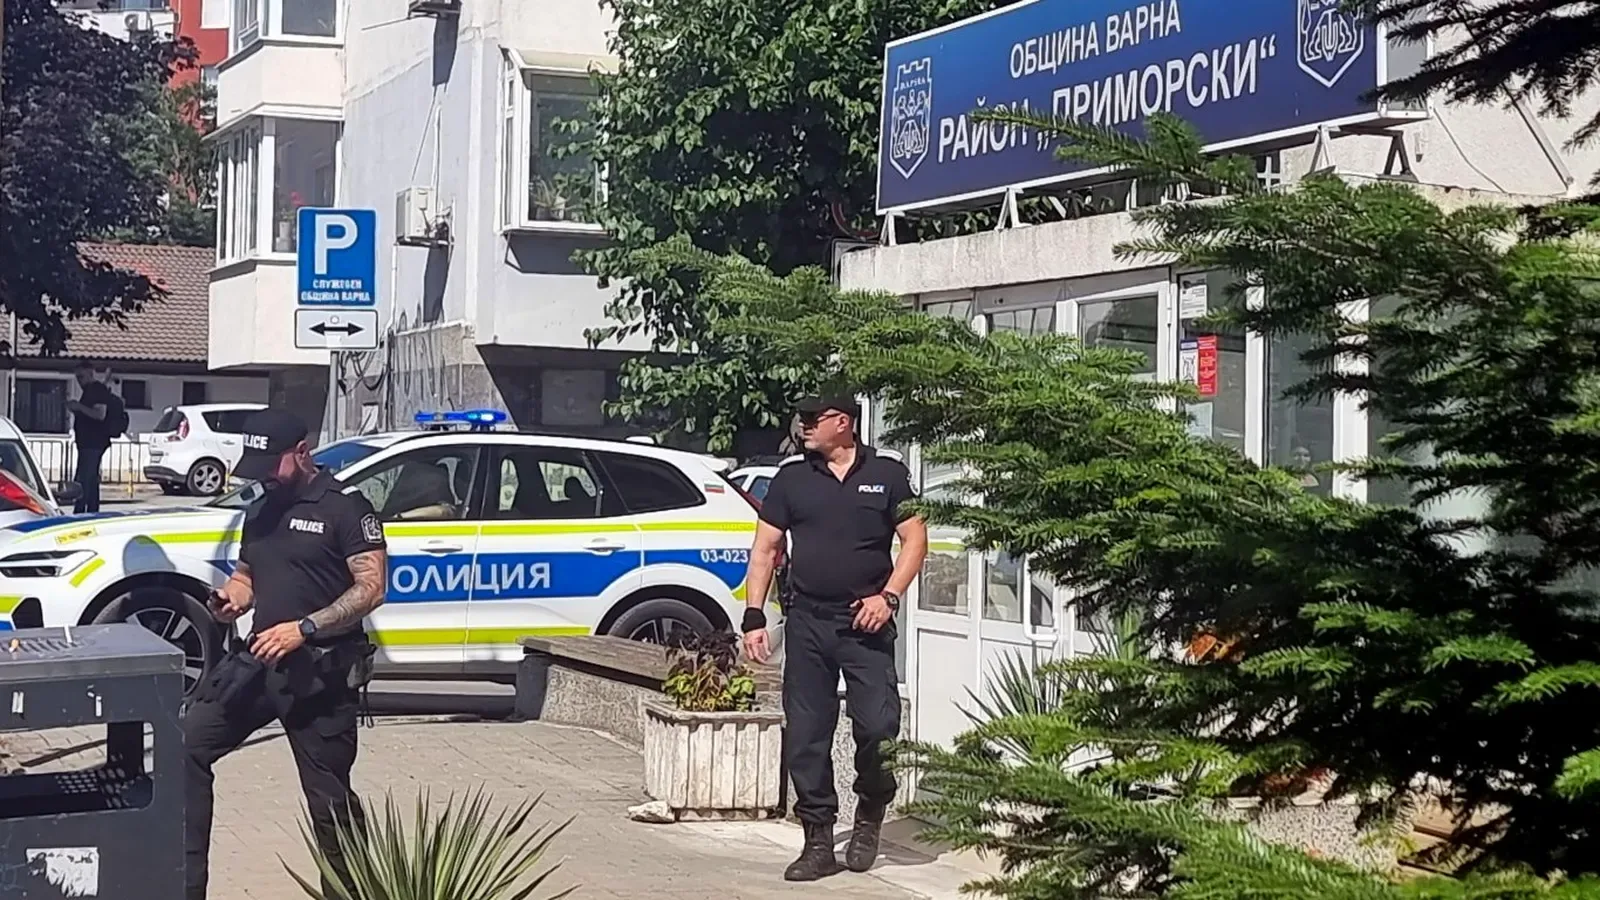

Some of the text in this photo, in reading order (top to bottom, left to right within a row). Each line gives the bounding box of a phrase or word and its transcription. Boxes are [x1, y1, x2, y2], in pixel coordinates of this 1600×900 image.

[1010, 0, 1181, 79] ОБЩИНА ВАРНА
[937, 96, 1028, 163] РАЙОН
[314, 213, 358, 275] P
[301, 291, 371, 302] ОБЩИНА ВАРНА
[243, 434, 269, 450] LICE
[858, 484, 884, 493] POLICE
[289, 518, 324, 534] POLICE
[700, 549, 749, 563] 03-023
[386, 562, 551, 595] ОЛИЦИЯ
